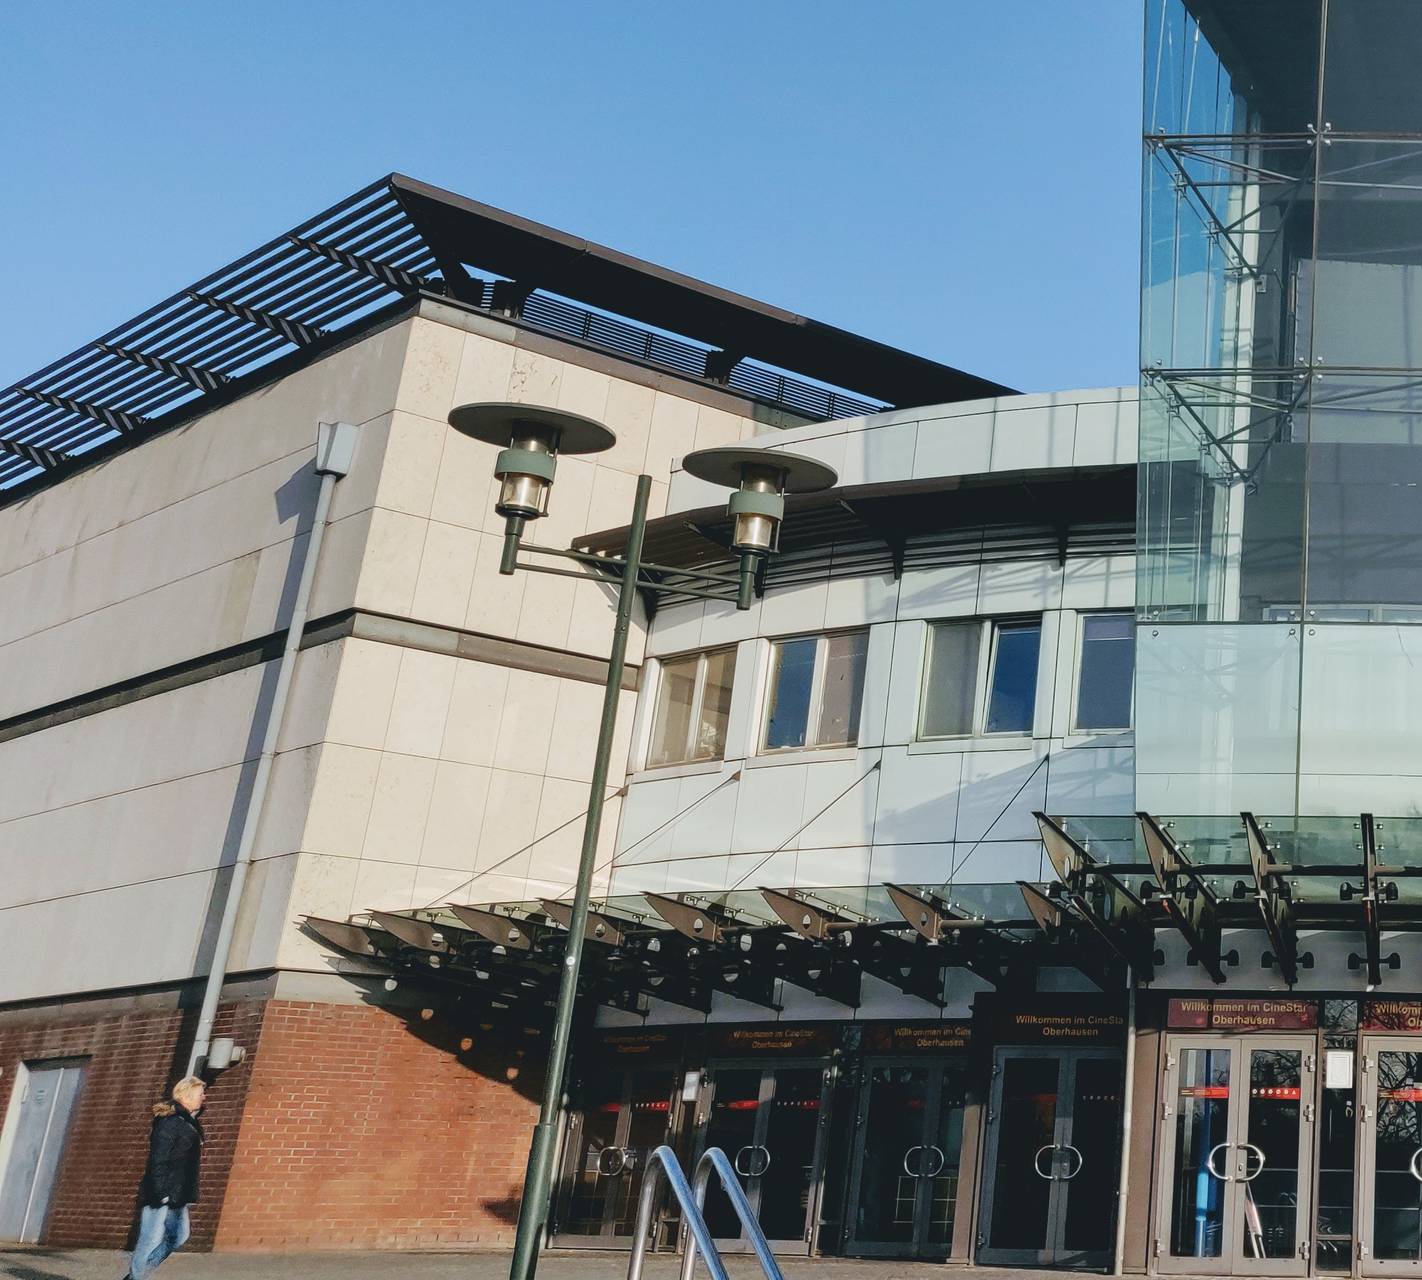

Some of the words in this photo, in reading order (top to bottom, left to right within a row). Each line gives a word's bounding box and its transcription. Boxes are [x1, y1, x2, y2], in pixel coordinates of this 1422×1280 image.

[1181, 1001, 1244, 1012] Willkommen
[1247, 1002, 1260, 1012] im
[1263, 1003, 1308, 1013] CineStar
[1016, 1015, 1072, 1025] Willkommen
[1074, 1015, 1085, 1025] im
[1088, 1016, 1124, 1025] CineSta
[1212, 1015, 1275, 1025] Oberhausen
[1042, 1026, 1099, 1037] Oberhausen
